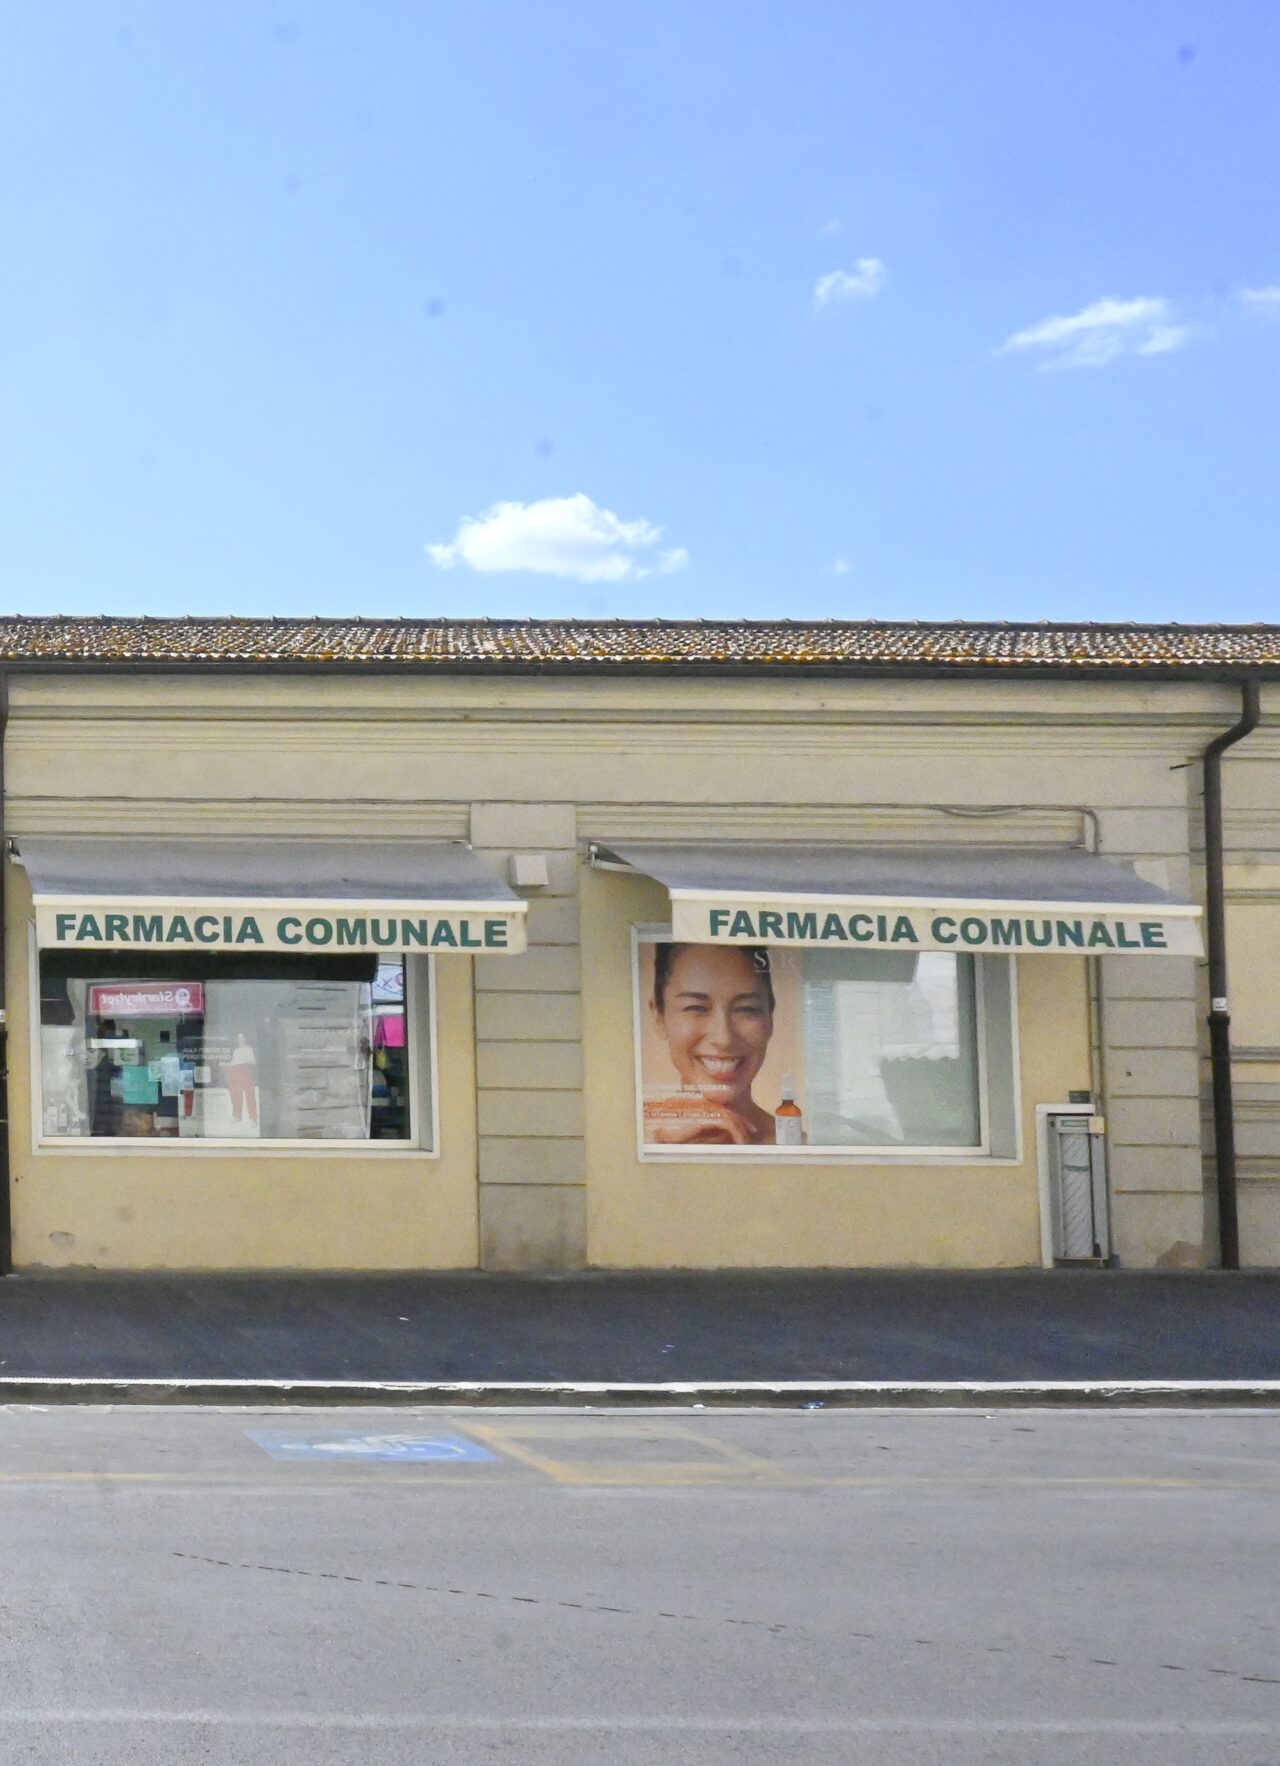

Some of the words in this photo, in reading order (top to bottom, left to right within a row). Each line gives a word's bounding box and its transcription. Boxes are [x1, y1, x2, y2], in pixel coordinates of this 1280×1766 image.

[56, 914, 263, 943] FARMACIA
[277, 917, 507, 948] COMUNALE
[710, 910, 918, 942] FARMACIA
[932, 917, 1167, 948] COMUNALE
